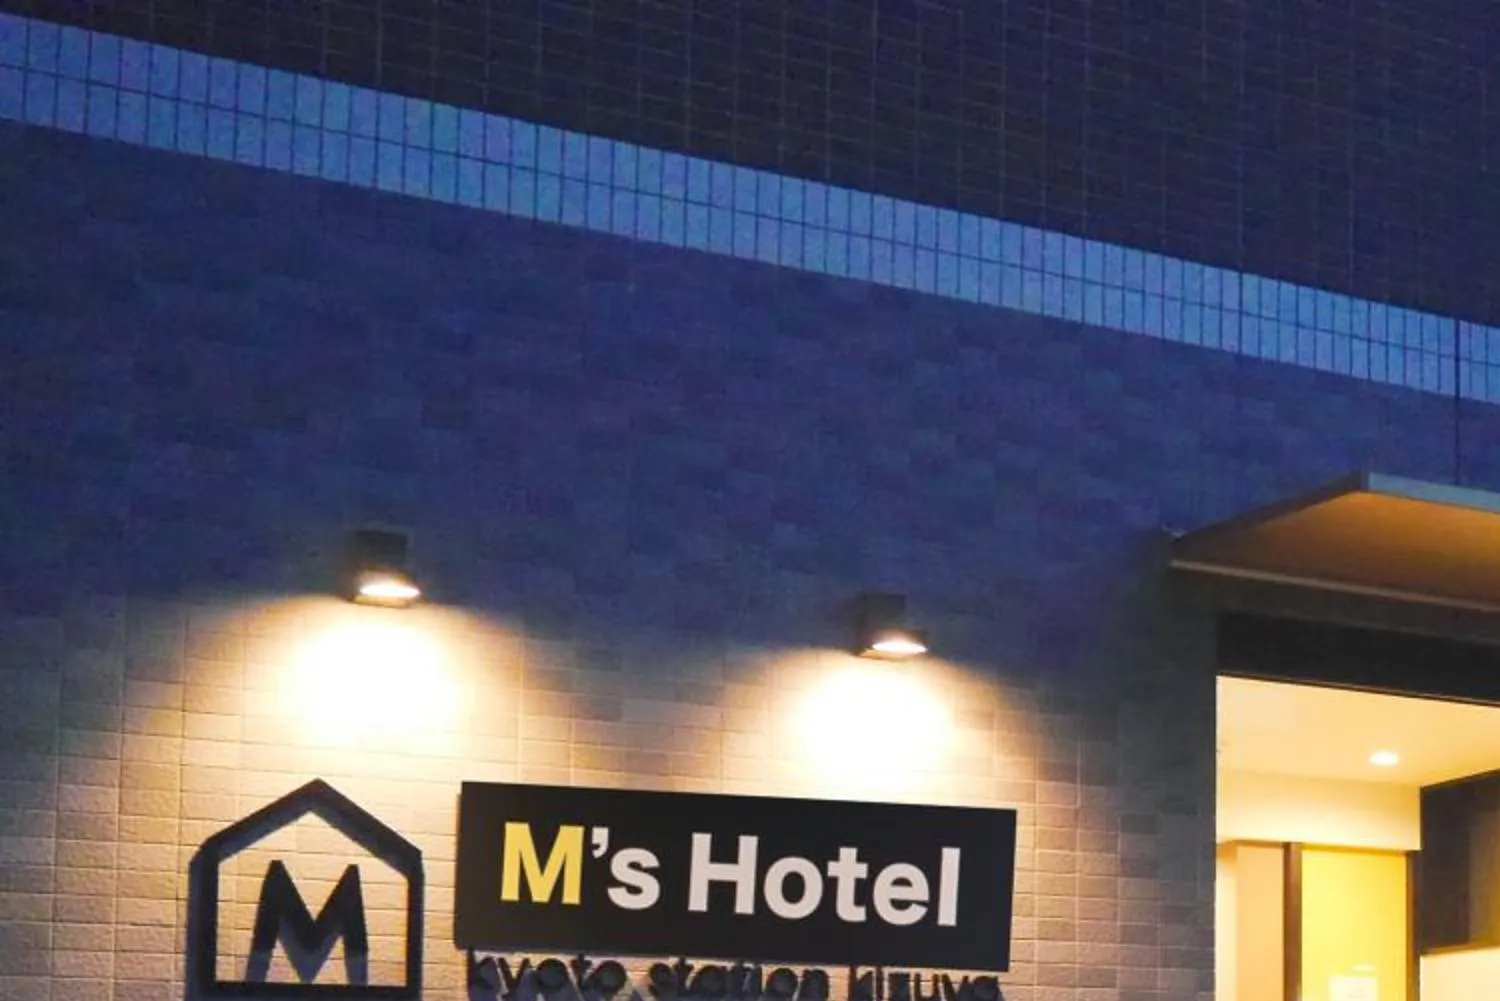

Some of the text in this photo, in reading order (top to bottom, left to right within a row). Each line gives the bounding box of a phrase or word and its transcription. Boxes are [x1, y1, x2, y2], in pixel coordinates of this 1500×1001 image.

[249, 859, 368, 958] M
[500, 821, 962, 928] M's Hotel
